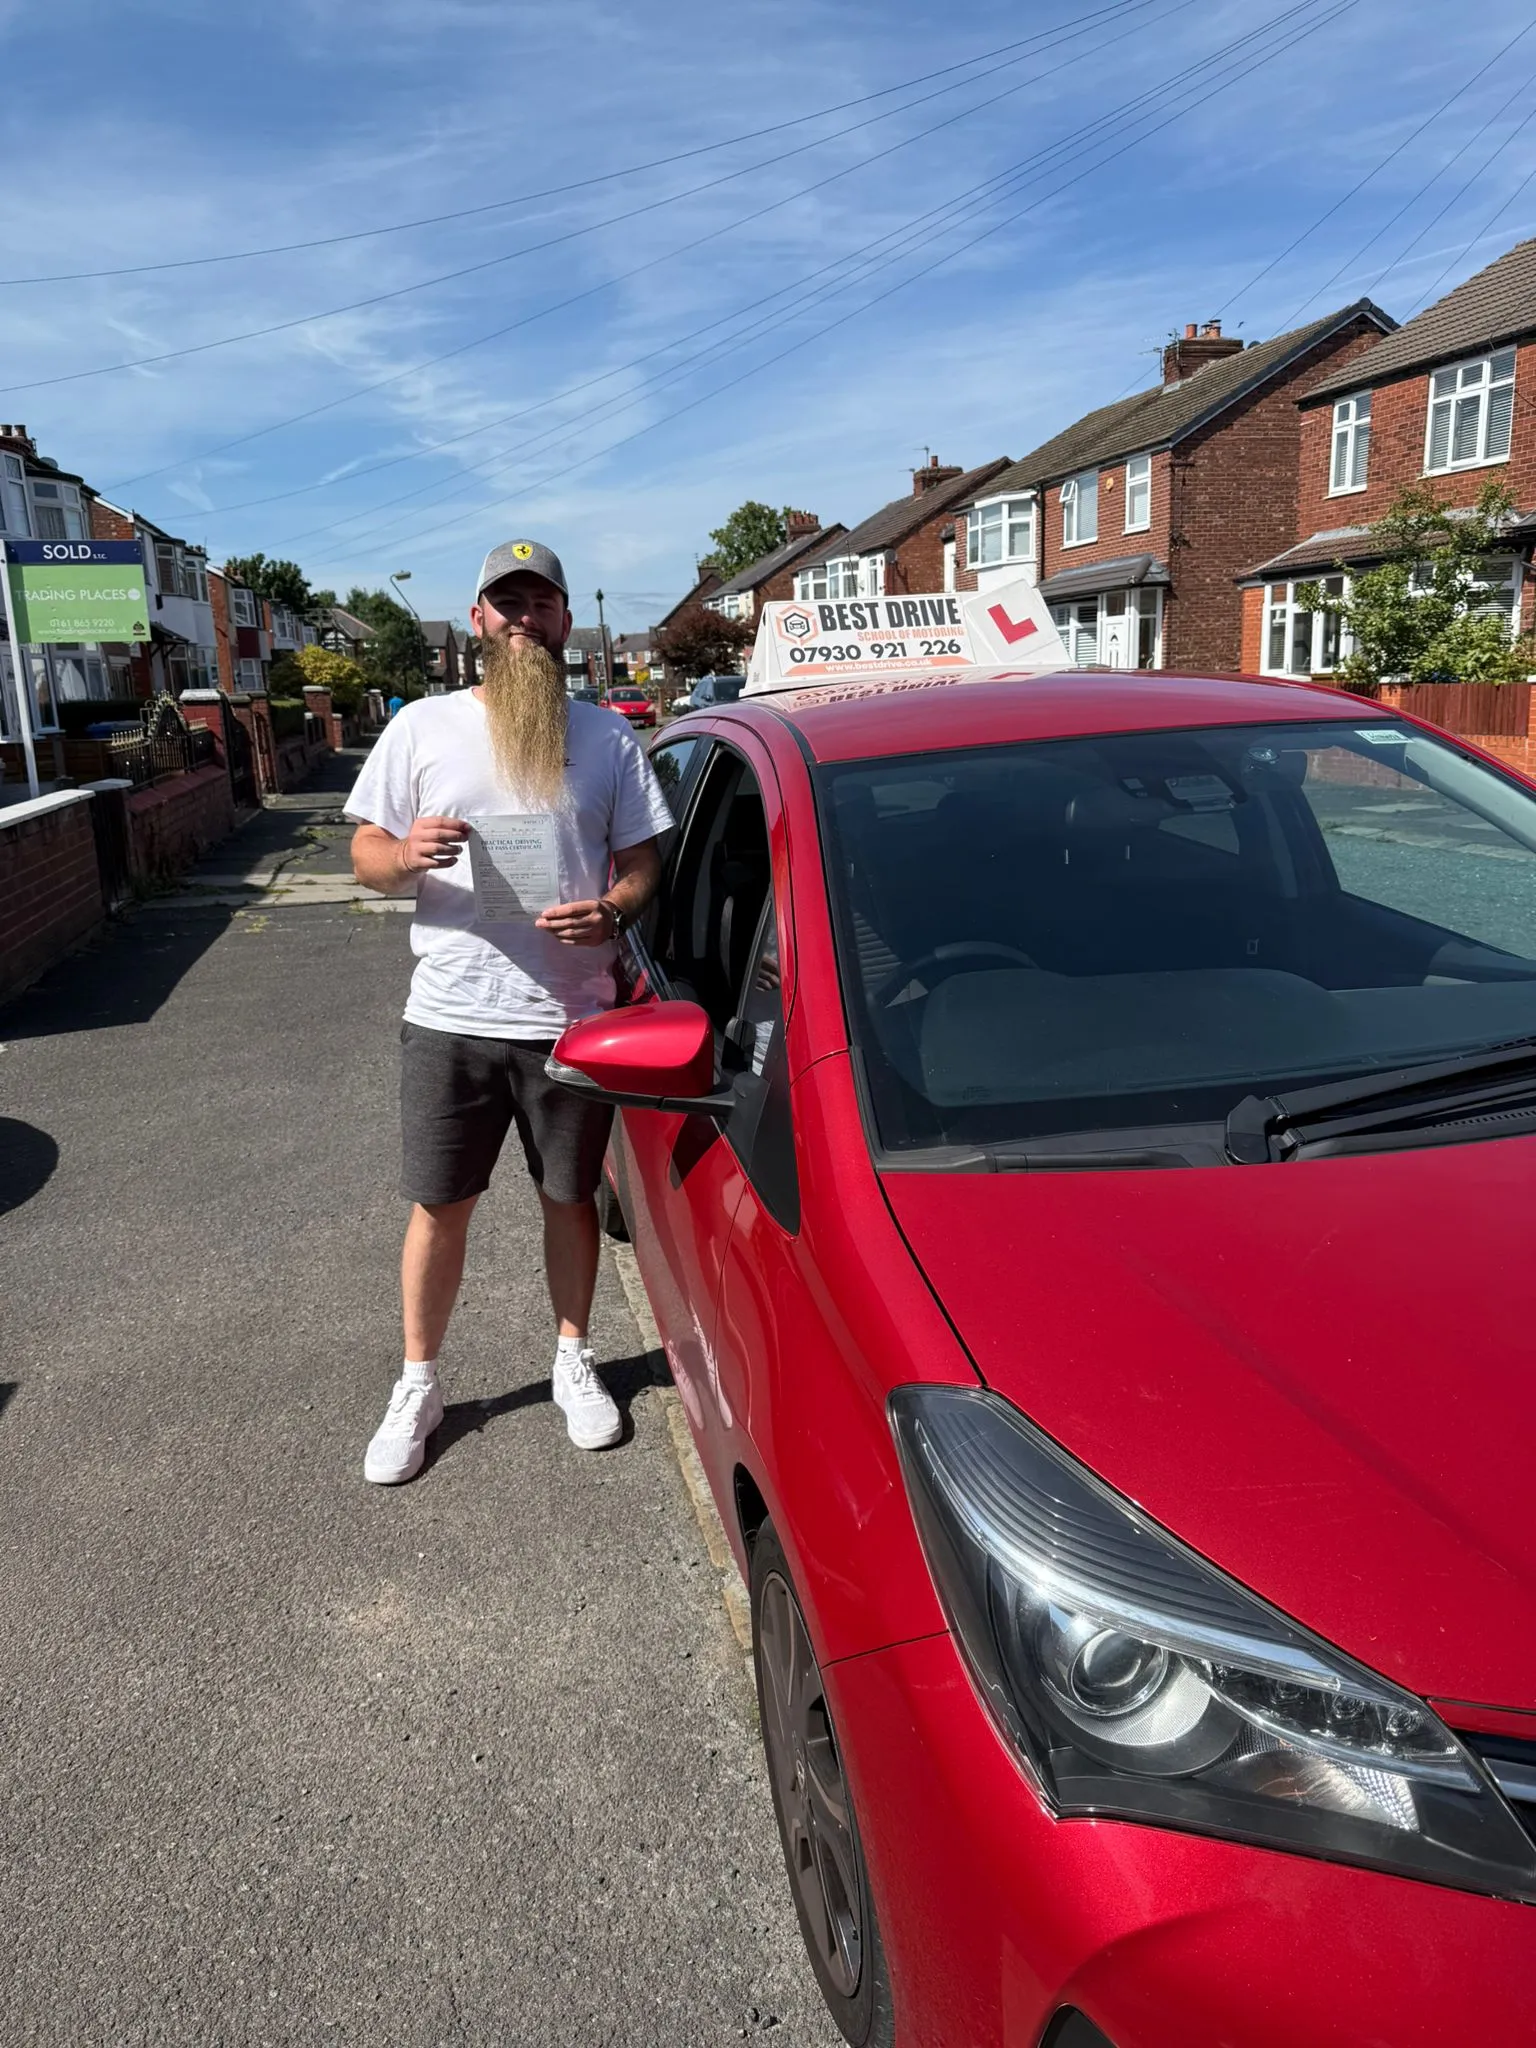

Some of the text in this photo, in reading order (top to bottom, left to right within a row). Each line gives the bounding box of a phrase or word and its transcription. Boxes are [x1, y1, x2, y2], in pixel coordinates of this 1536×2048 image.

[42, 544, 91, 559] SOLD
[15, 588, 127, 601] TRADING PLACES
[818, 598, 962, 632] BEST DRIVE
[50, 619, 71, 628] 0161
[93, 618, 115, 627] 9220
[987, 603, 1039, 645] L
[857, 627, 965, 642] SCHOOL OF MOTORING
[789, 639, 961, 663] 07930 921 226
[825, 658, 933, 673] www.bestdrive.co.uk
